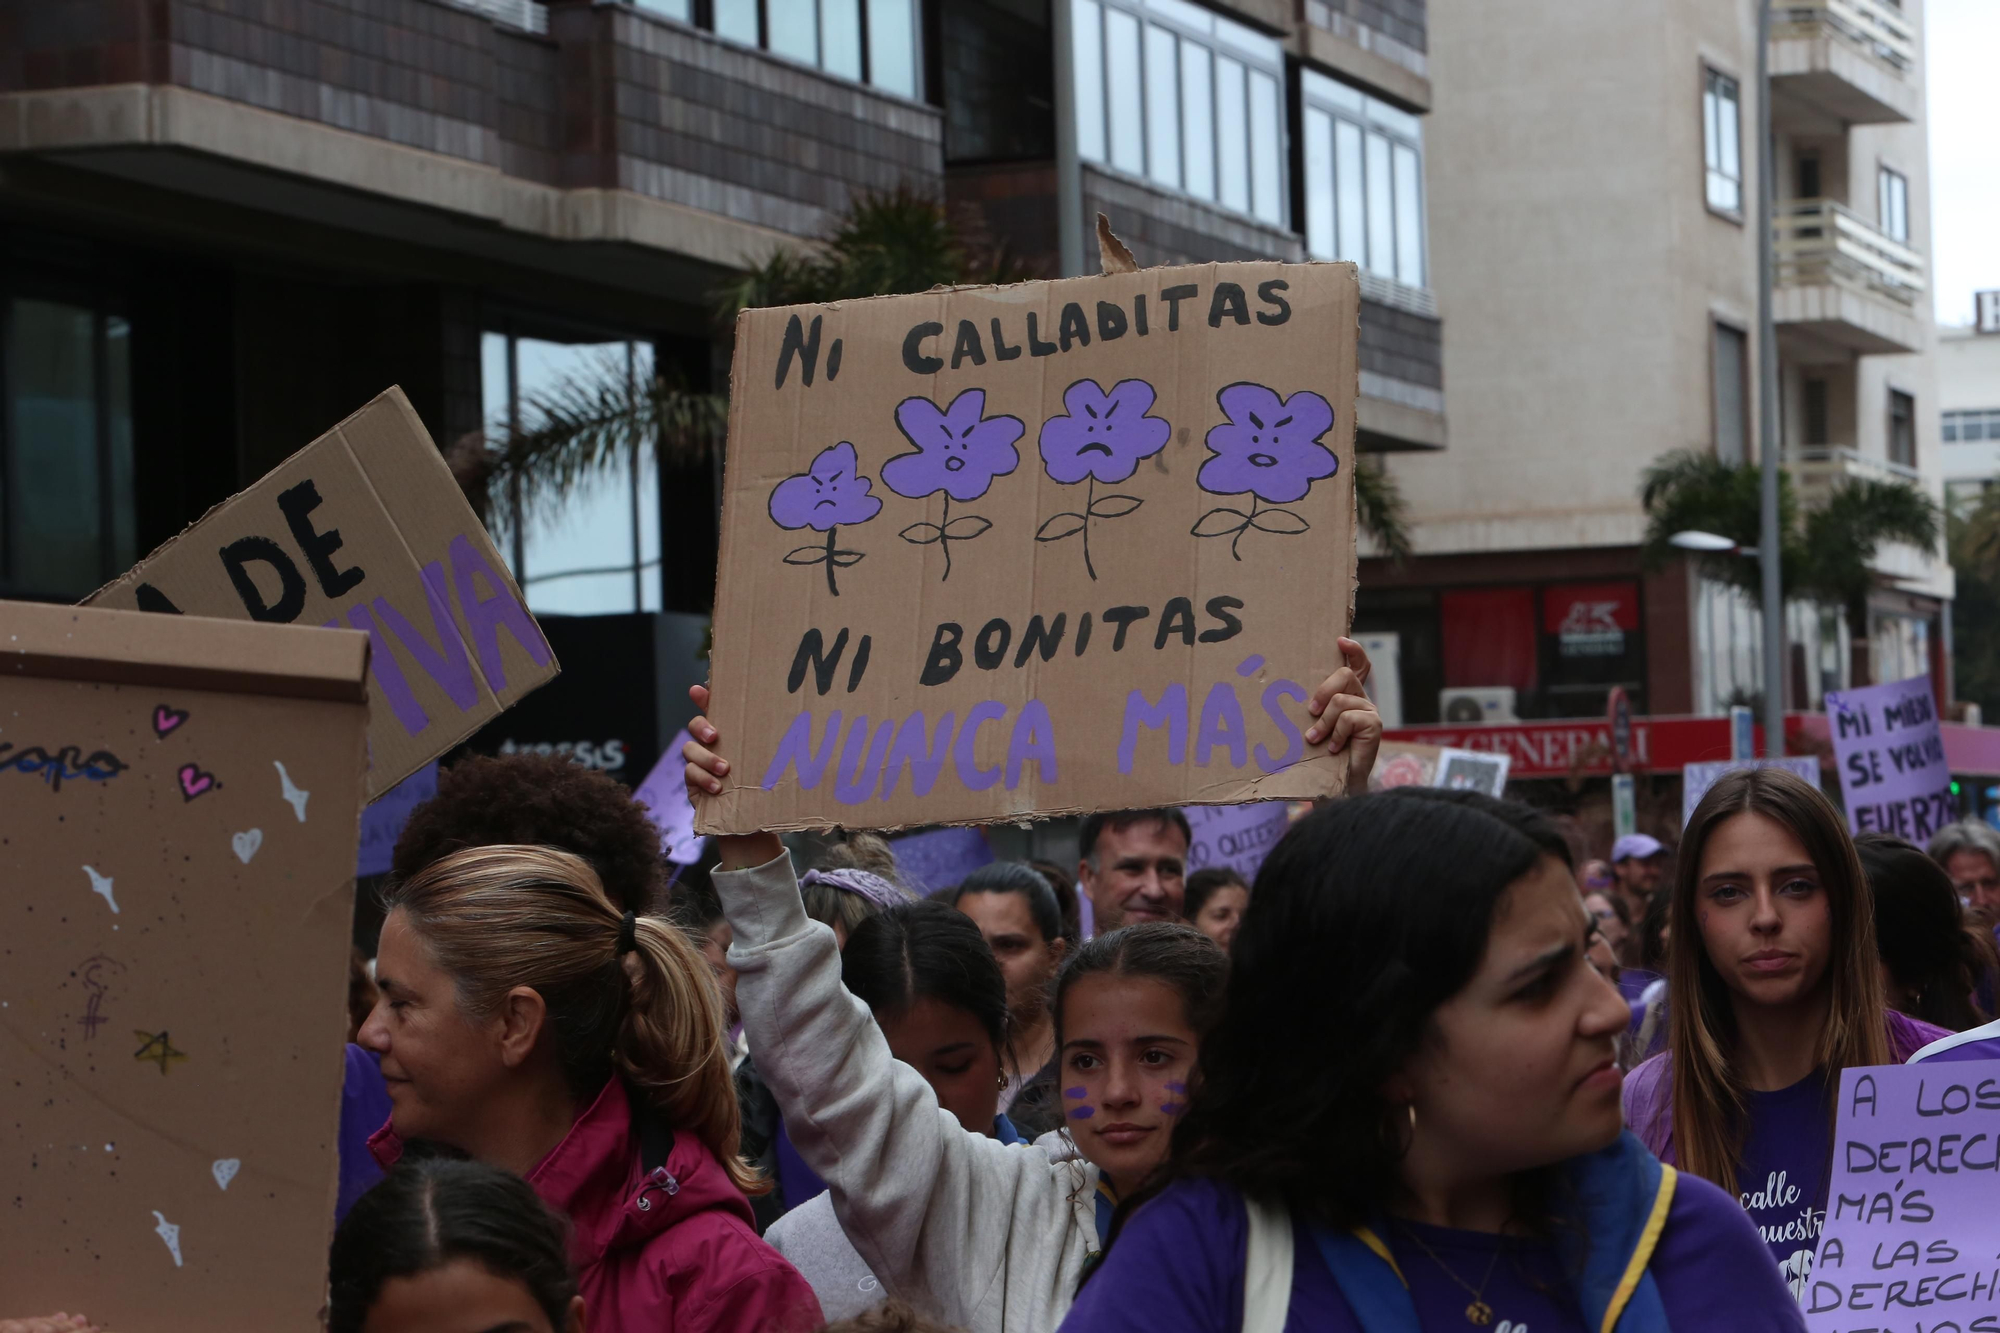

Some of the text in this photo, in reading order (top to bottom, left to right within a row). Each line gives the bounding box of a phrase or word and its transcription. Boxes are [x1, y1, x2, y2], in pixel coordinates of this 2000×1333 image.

[776, 279, 1292, 390] NI CALLADITAS
[219, 478, 366, 624] DE
[322, 534, 552, 737] IVA
[787, 596, 1245, 696] NI BONITAS
[761, 699, 1058, 806] NUNCA
[1117, 654, 1308, 775] MÁS
[1847, 749, 1884, 789] SE
[1852, 1074, 2000, 1118] A LOS
[1846, 1133, 2000, 1175] DEREC
[1835, 1179, 1934, 1224] MÁS
[1819, 1237, 1845, 1269] A
[1872, 1239, 1960, 1271] LAS
